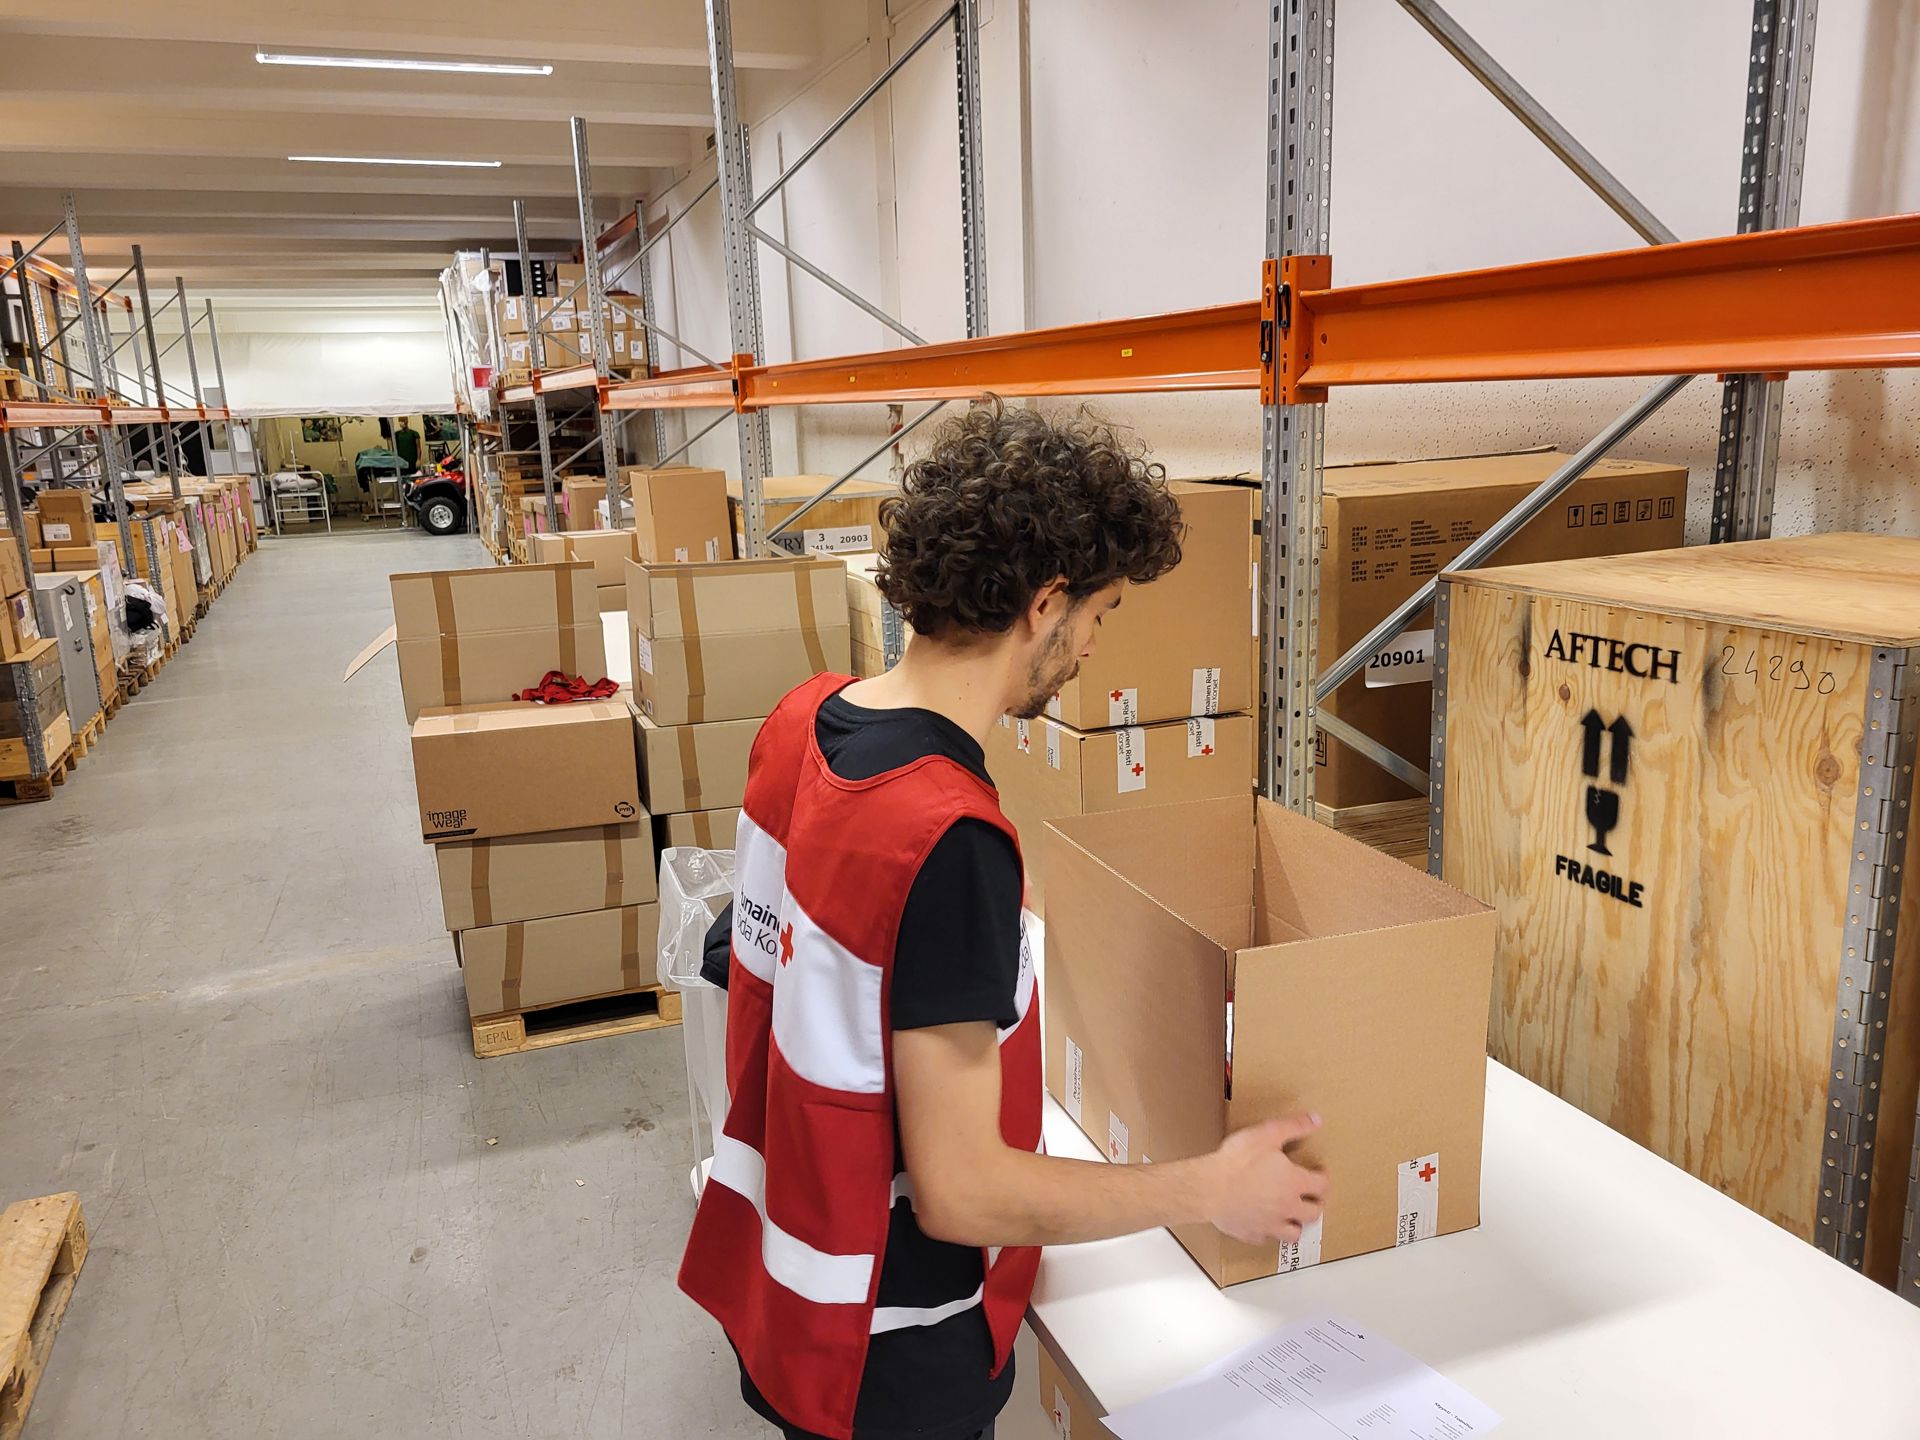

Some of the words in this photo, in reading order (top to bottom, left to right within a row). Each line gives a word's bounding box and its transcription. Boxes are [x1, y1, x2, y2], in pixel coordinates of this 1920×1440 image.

[818, 533, 825, 542] 3
[840, 534, 868, 544] 20903
[1369, 649, 1425, 668] 20901
[1544, 628, 1683, 685] AFTECH
[1125, 749, 1133, 766] Risti
[427, 809, 467, 821] image
[433, 817, 467, 829] wear
[1555, 854, 1645, 909] FRAGILE
[754, 928, 778, 957] Ko
[486, 1030, 513, 1044] EPAL
[1409, 1158, 1419, 1170] ti
[1398, 1214, 1409, 1239] Röda
[1281, 1240, 1289, 1266] orset
